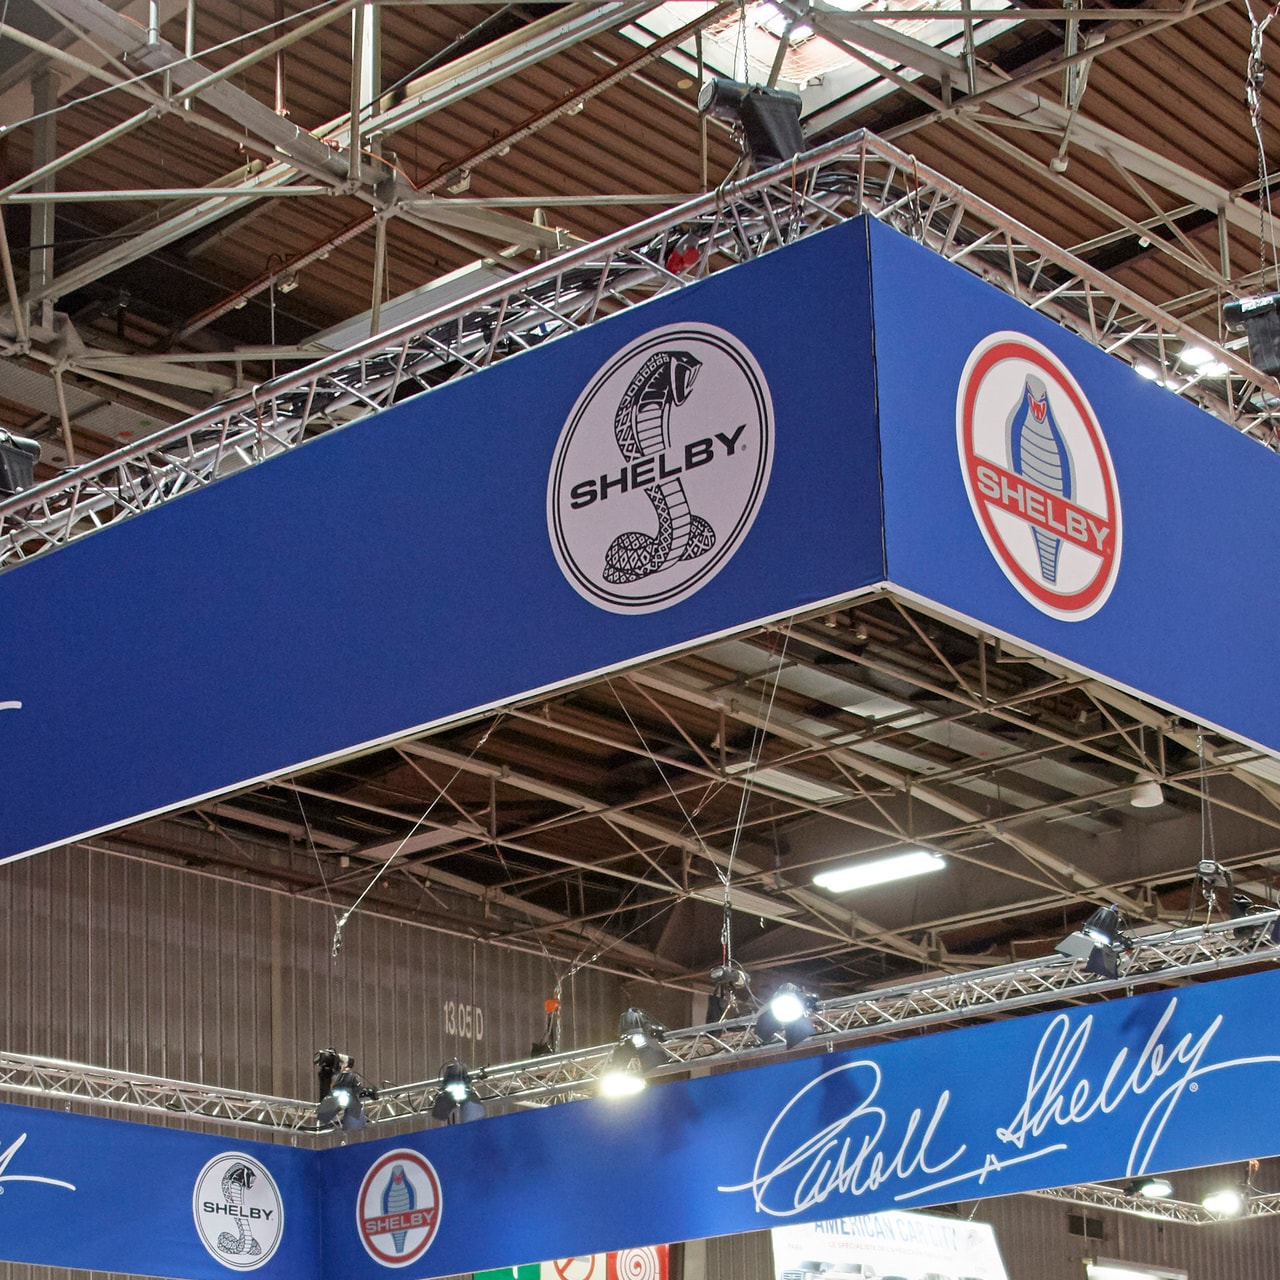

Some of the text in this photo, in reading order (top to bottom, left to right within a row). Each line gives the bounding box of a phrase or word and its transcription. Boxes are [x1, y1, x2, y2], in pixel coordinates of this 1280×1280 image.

[570, 423, 748, 510] SHELBY
[976, 463, 1111, 553] SHELBY
[202, 1202, 274, 1221] SHELBY
[365, 1210, 435, 1234] SHELBY
